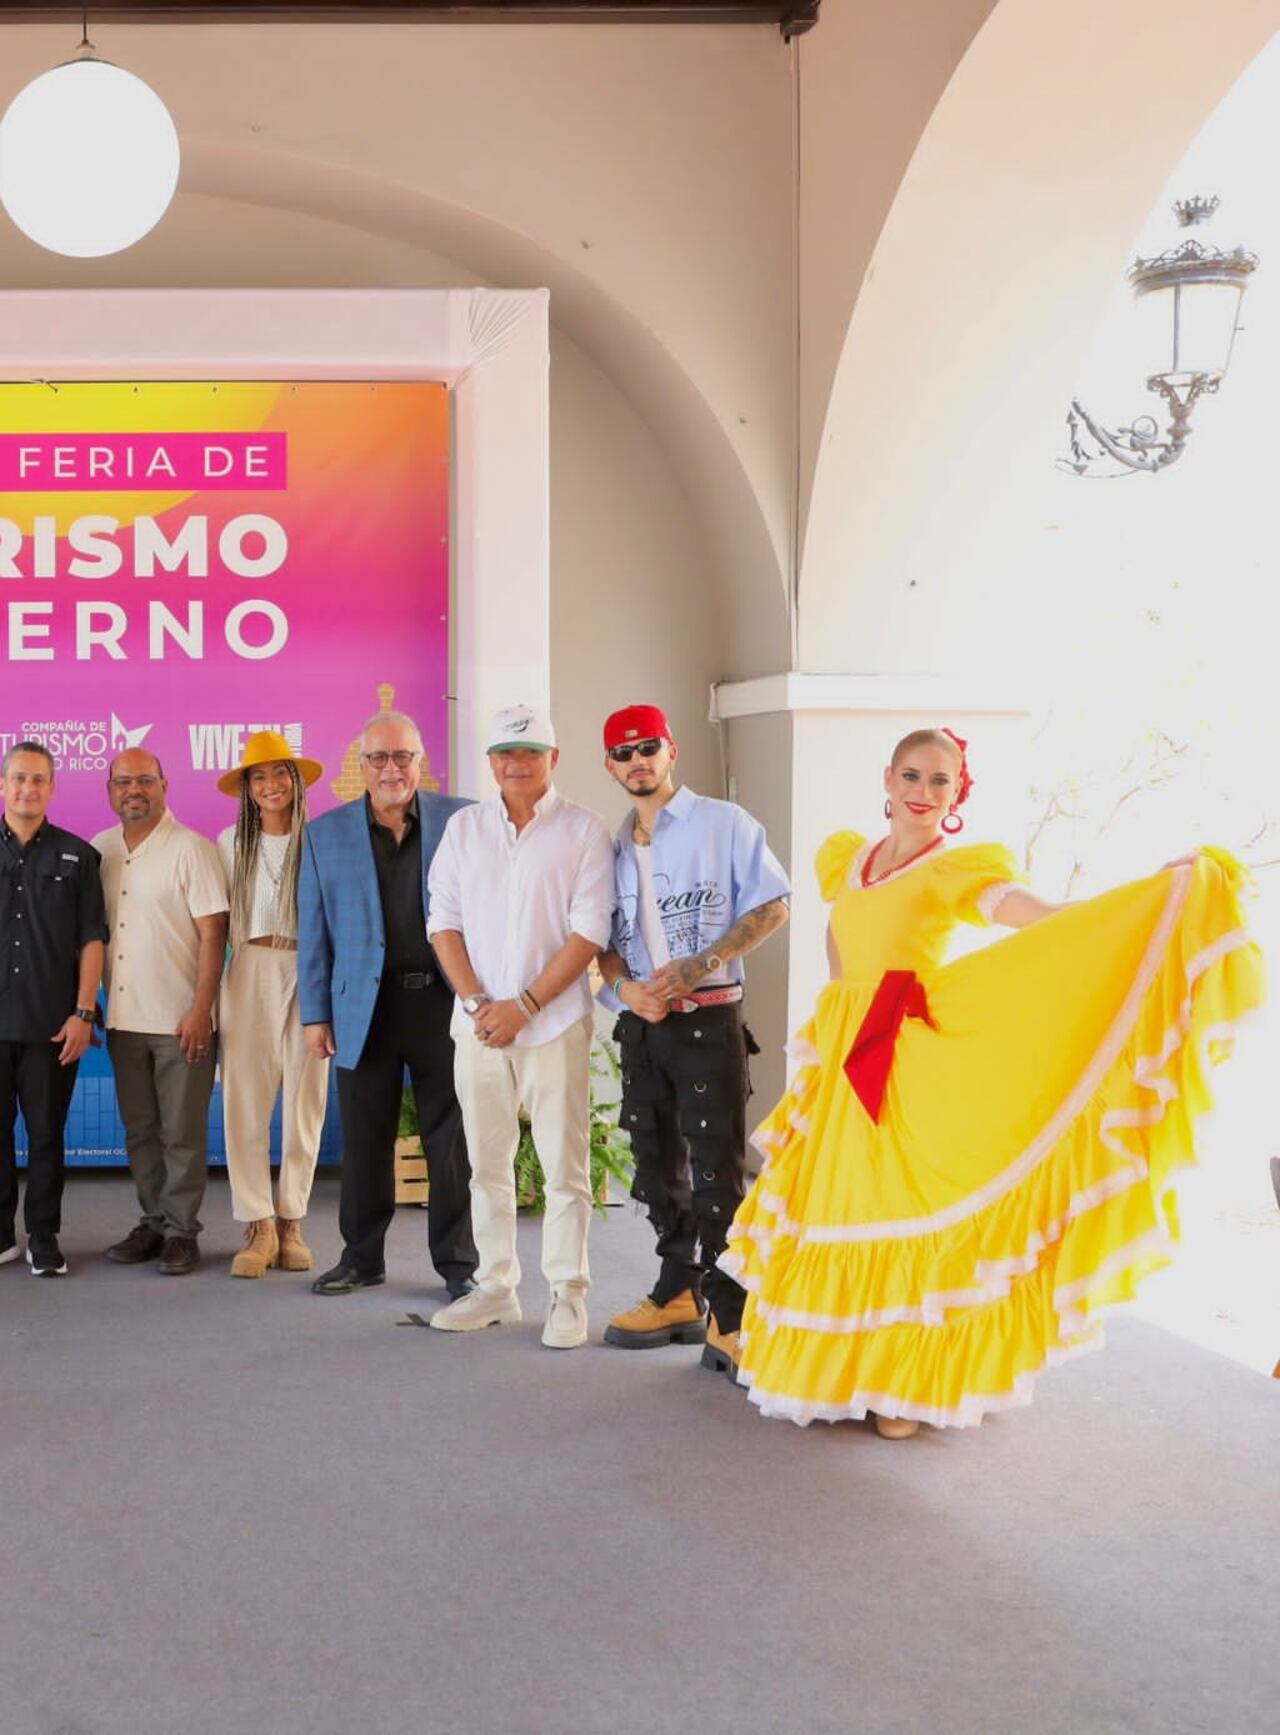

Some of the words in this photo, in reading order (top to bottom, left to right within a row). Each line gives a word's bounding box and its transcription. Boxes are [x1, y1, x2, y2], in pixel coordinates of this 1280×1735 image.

[19, 447, 175, 478] FERIA
[204, 446, 268, 476] DE
[22, 719, 86, 732] COMPAÑÍA
[89, 721, 107, 732] DE
[69, 757, 108, 771] RICO
